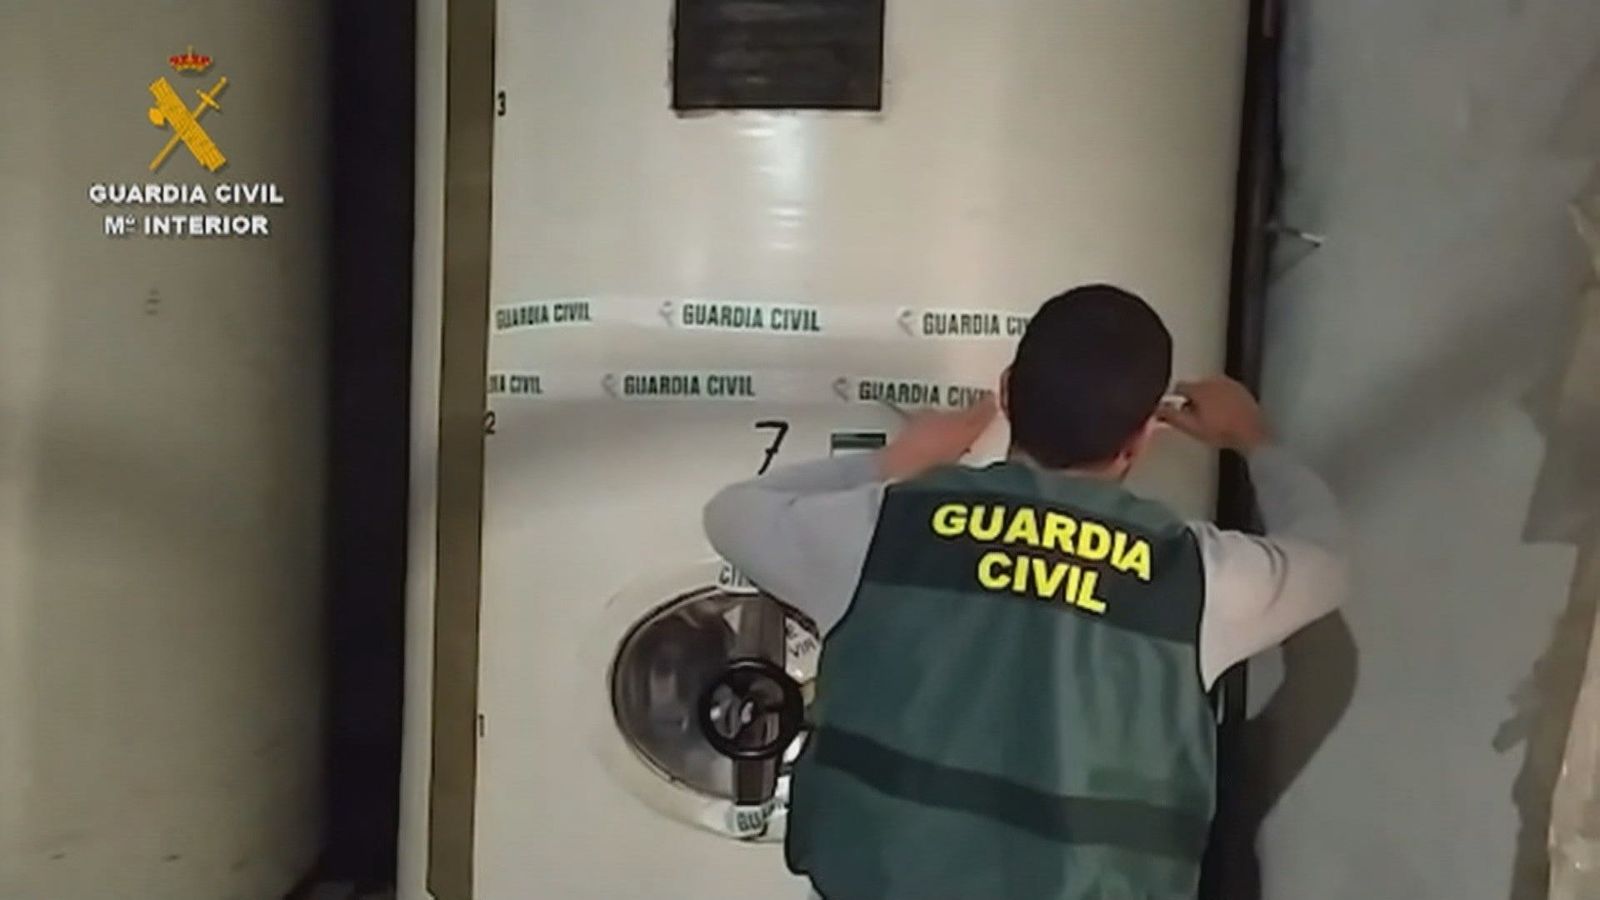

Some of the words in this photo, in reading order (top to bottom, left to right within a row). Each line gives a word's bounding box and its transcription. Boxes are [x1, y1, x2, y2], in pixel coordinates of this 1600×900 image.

[497, 90, 506, 116] 3
[495, 304, 549, 330] GUARDIA
[553, 301, 592, 323] CIVIL
[682, 303, 764, 329] GUARDIA
[770, 307, 821, 332] CIVIL
[922, 311, 1000, 336] GUARDIA
[510, 374, 544, 395] CIVIL
[623, 374, 700, 396] GUARDIA
[706, 374, 756, 397] CIVIL
[858, 380, 941, 406] GUARDIA
[946, 385, 994, 408] CIV
[481, 411, 496, 435] 2
[754, 420, 789, 476] 7
[931, 502, 1151, 582] GUARDIA
[977, 551, 1107, 614] CIVIL
[478, 713, 485, 738] 1
